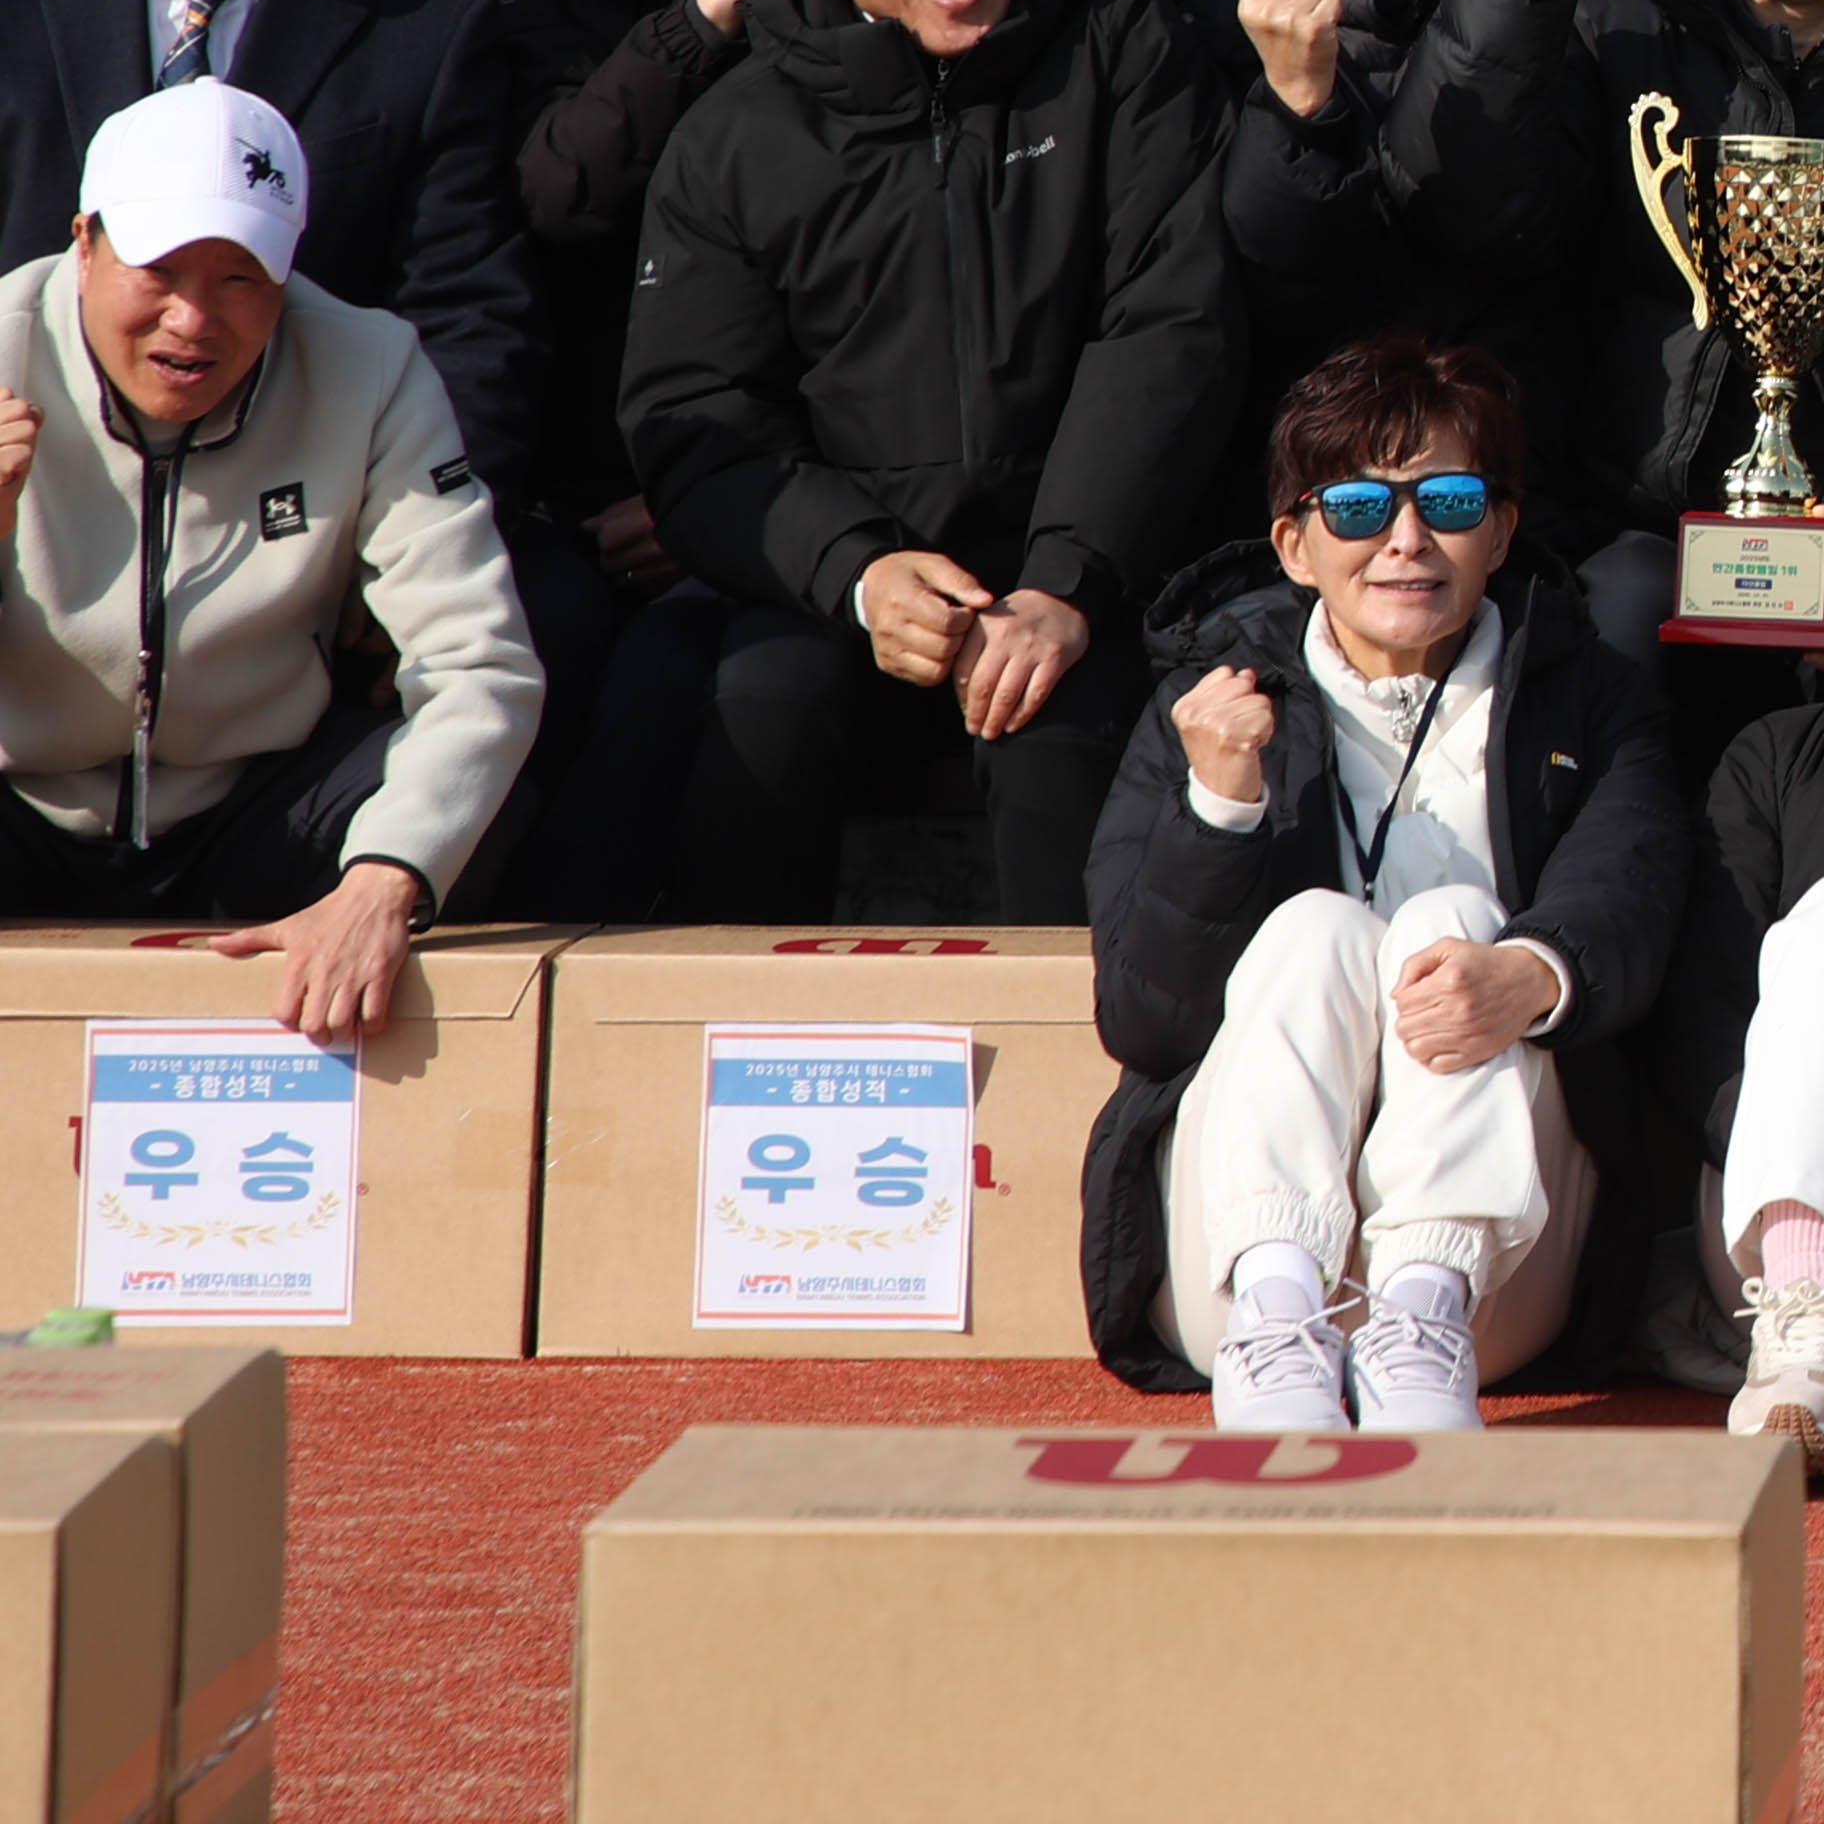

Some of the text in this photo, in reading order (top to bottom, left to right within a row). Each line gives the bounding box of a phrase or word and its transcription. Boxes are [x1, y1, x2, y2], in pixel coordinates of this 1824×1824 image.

[127, 1058, 320, 1073] 2025년 남양주시 테니스협회
[744, 1063, 933, 1079] 2025년 남양주시 테니스협회
[174, 1074, 272, 1099] 종합성적
[789, 1078, 888, 1103] 종합성적
[182, 1271, 313, 1289] 남양주시테니스협회
[797, 1276, 927, 1292] 남양주시테니스협회
